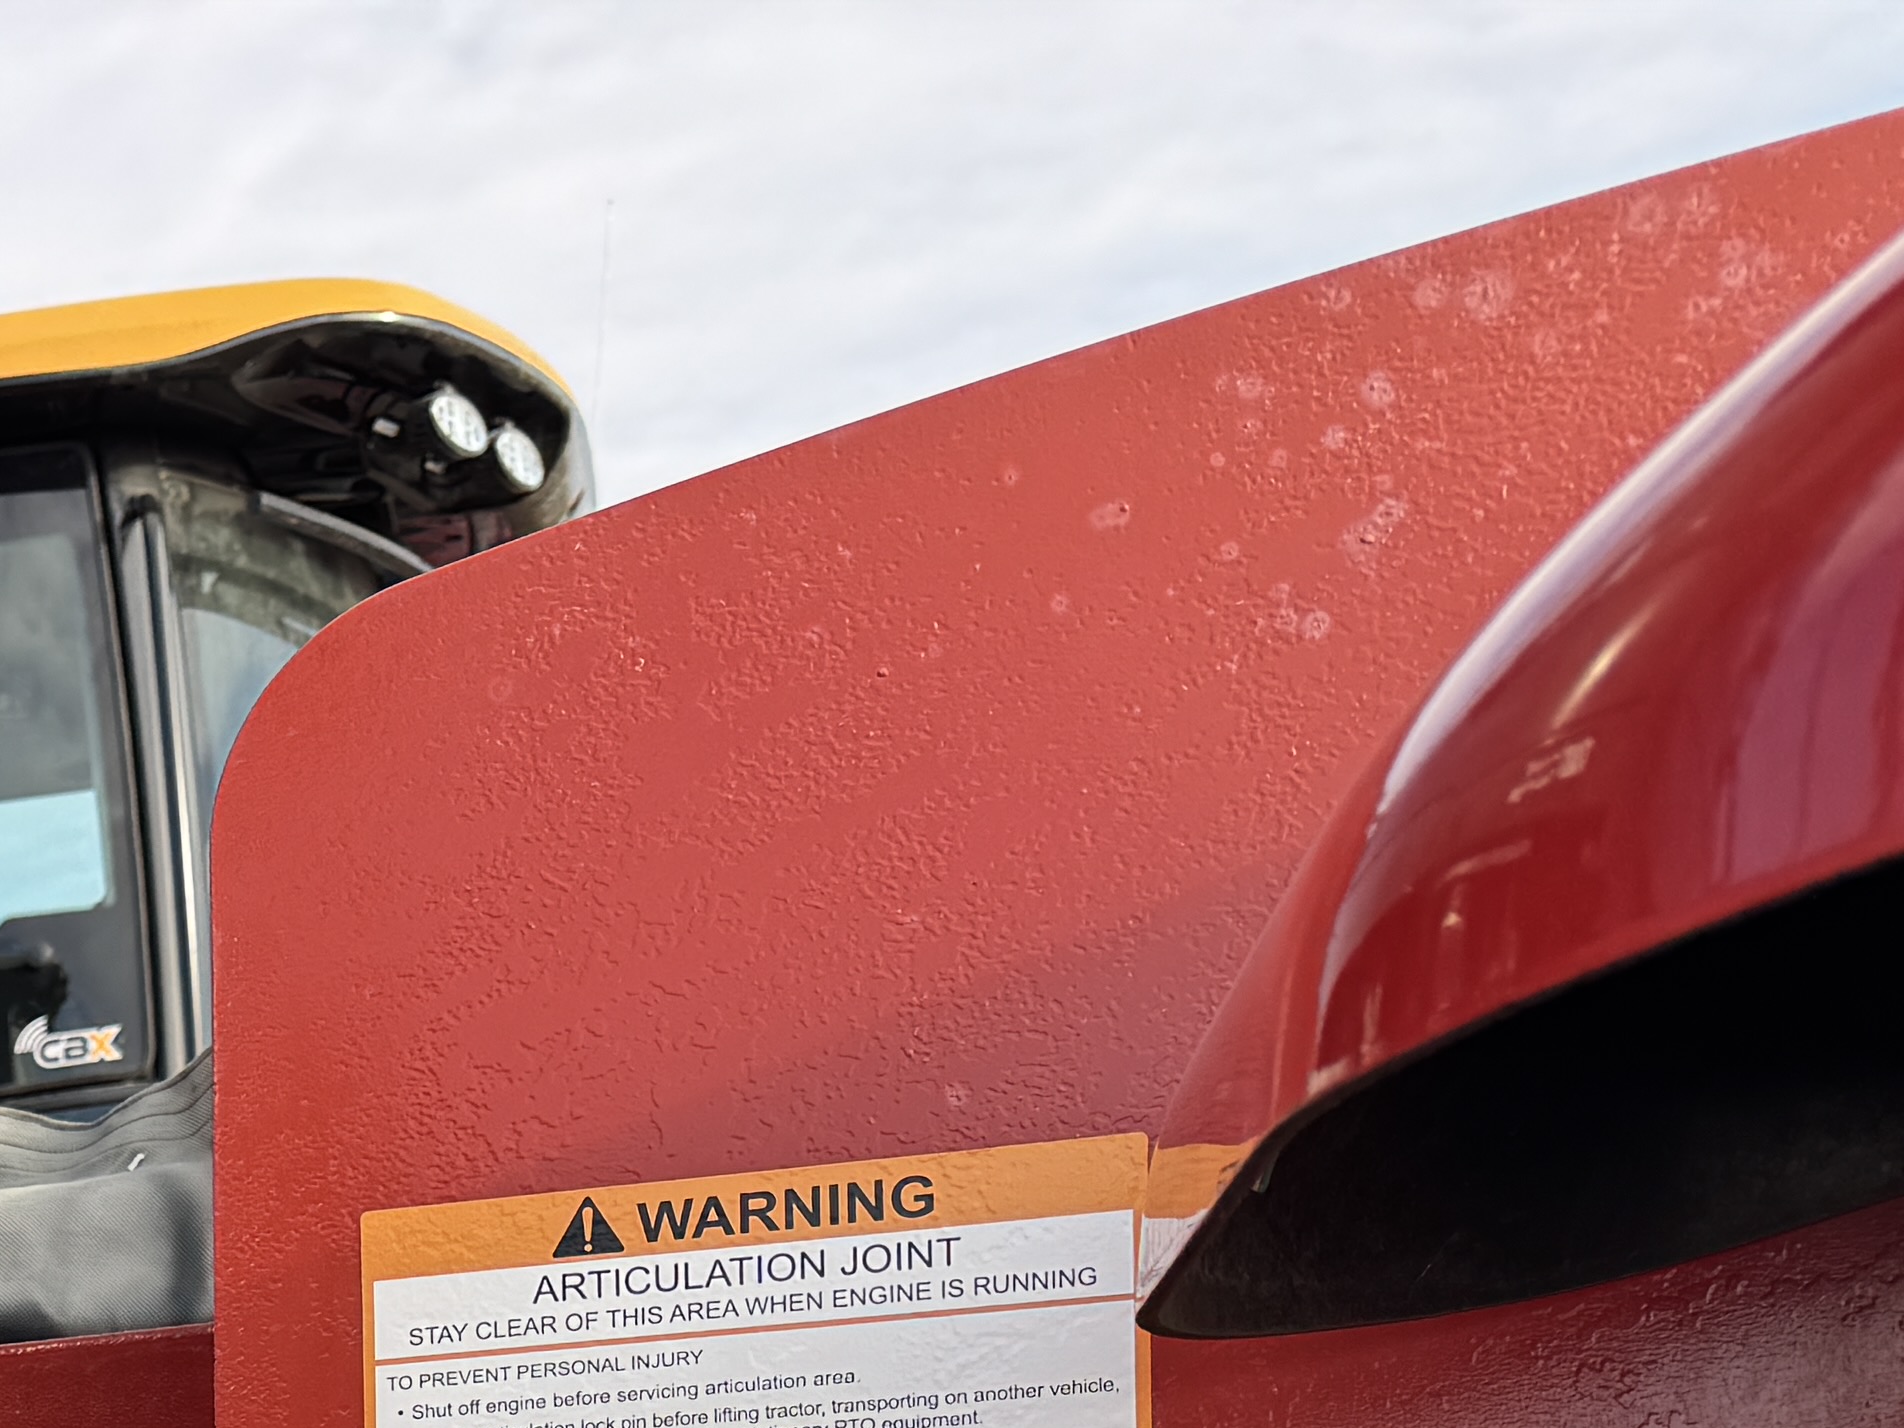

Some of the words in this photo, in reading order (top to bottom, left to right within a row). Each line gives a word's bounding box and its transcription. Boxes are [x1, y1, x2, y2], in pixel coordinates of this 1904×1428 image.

[637, 1175, 934, 1242] WARNING
[533, 1249, 826, 1304] ARTICULATION
[840, 1236, 961, 1277] JOINT
[409, 1323, 468, 1346] STAY
[475, 1316, 557, 1340] CLEAR
[565, 1312, 598, 1332] OF
[606, 1306, 663, 1329] THIS
[670, 1299, 739, 1324] AREA
[746, 1291, 823, 1316] WHEN
[832, 1281, 932, 1308] ENGINE
[942, 1279, 964, 1299] IS
[974, 1266, 1098, 1296] RUNNING
[387, 1375, 413, 1391] TO
[419, 1366, 511, 1389] PREVENT
[517, 1356, 625, 1380] PERSONAL
[631, 1350, 703, 1370] INJURY
[412, 1403, 452, 1420] Shut
[458, 1399, 481, 1416] off
[486, 1396, 546, 1415] engine
[553, 1389, 610, 1408] before
[617, 1382, 698, 1402] servicing
[705, 1373, 807, 1396] articulation
[813, 1371, 861, 1387] area.
[652, 1410, 708, 1428] before
[713, 1406, 759, 1425] lifting
[765, 1401, 826, 1420] tractor,
[832, 1392, 939, 1416] transporting
[945, 1390, 967, 1405] on
[974, 1384, 1045, 1403] another
[1050, 1378, 1120, 1397] vehicle,
